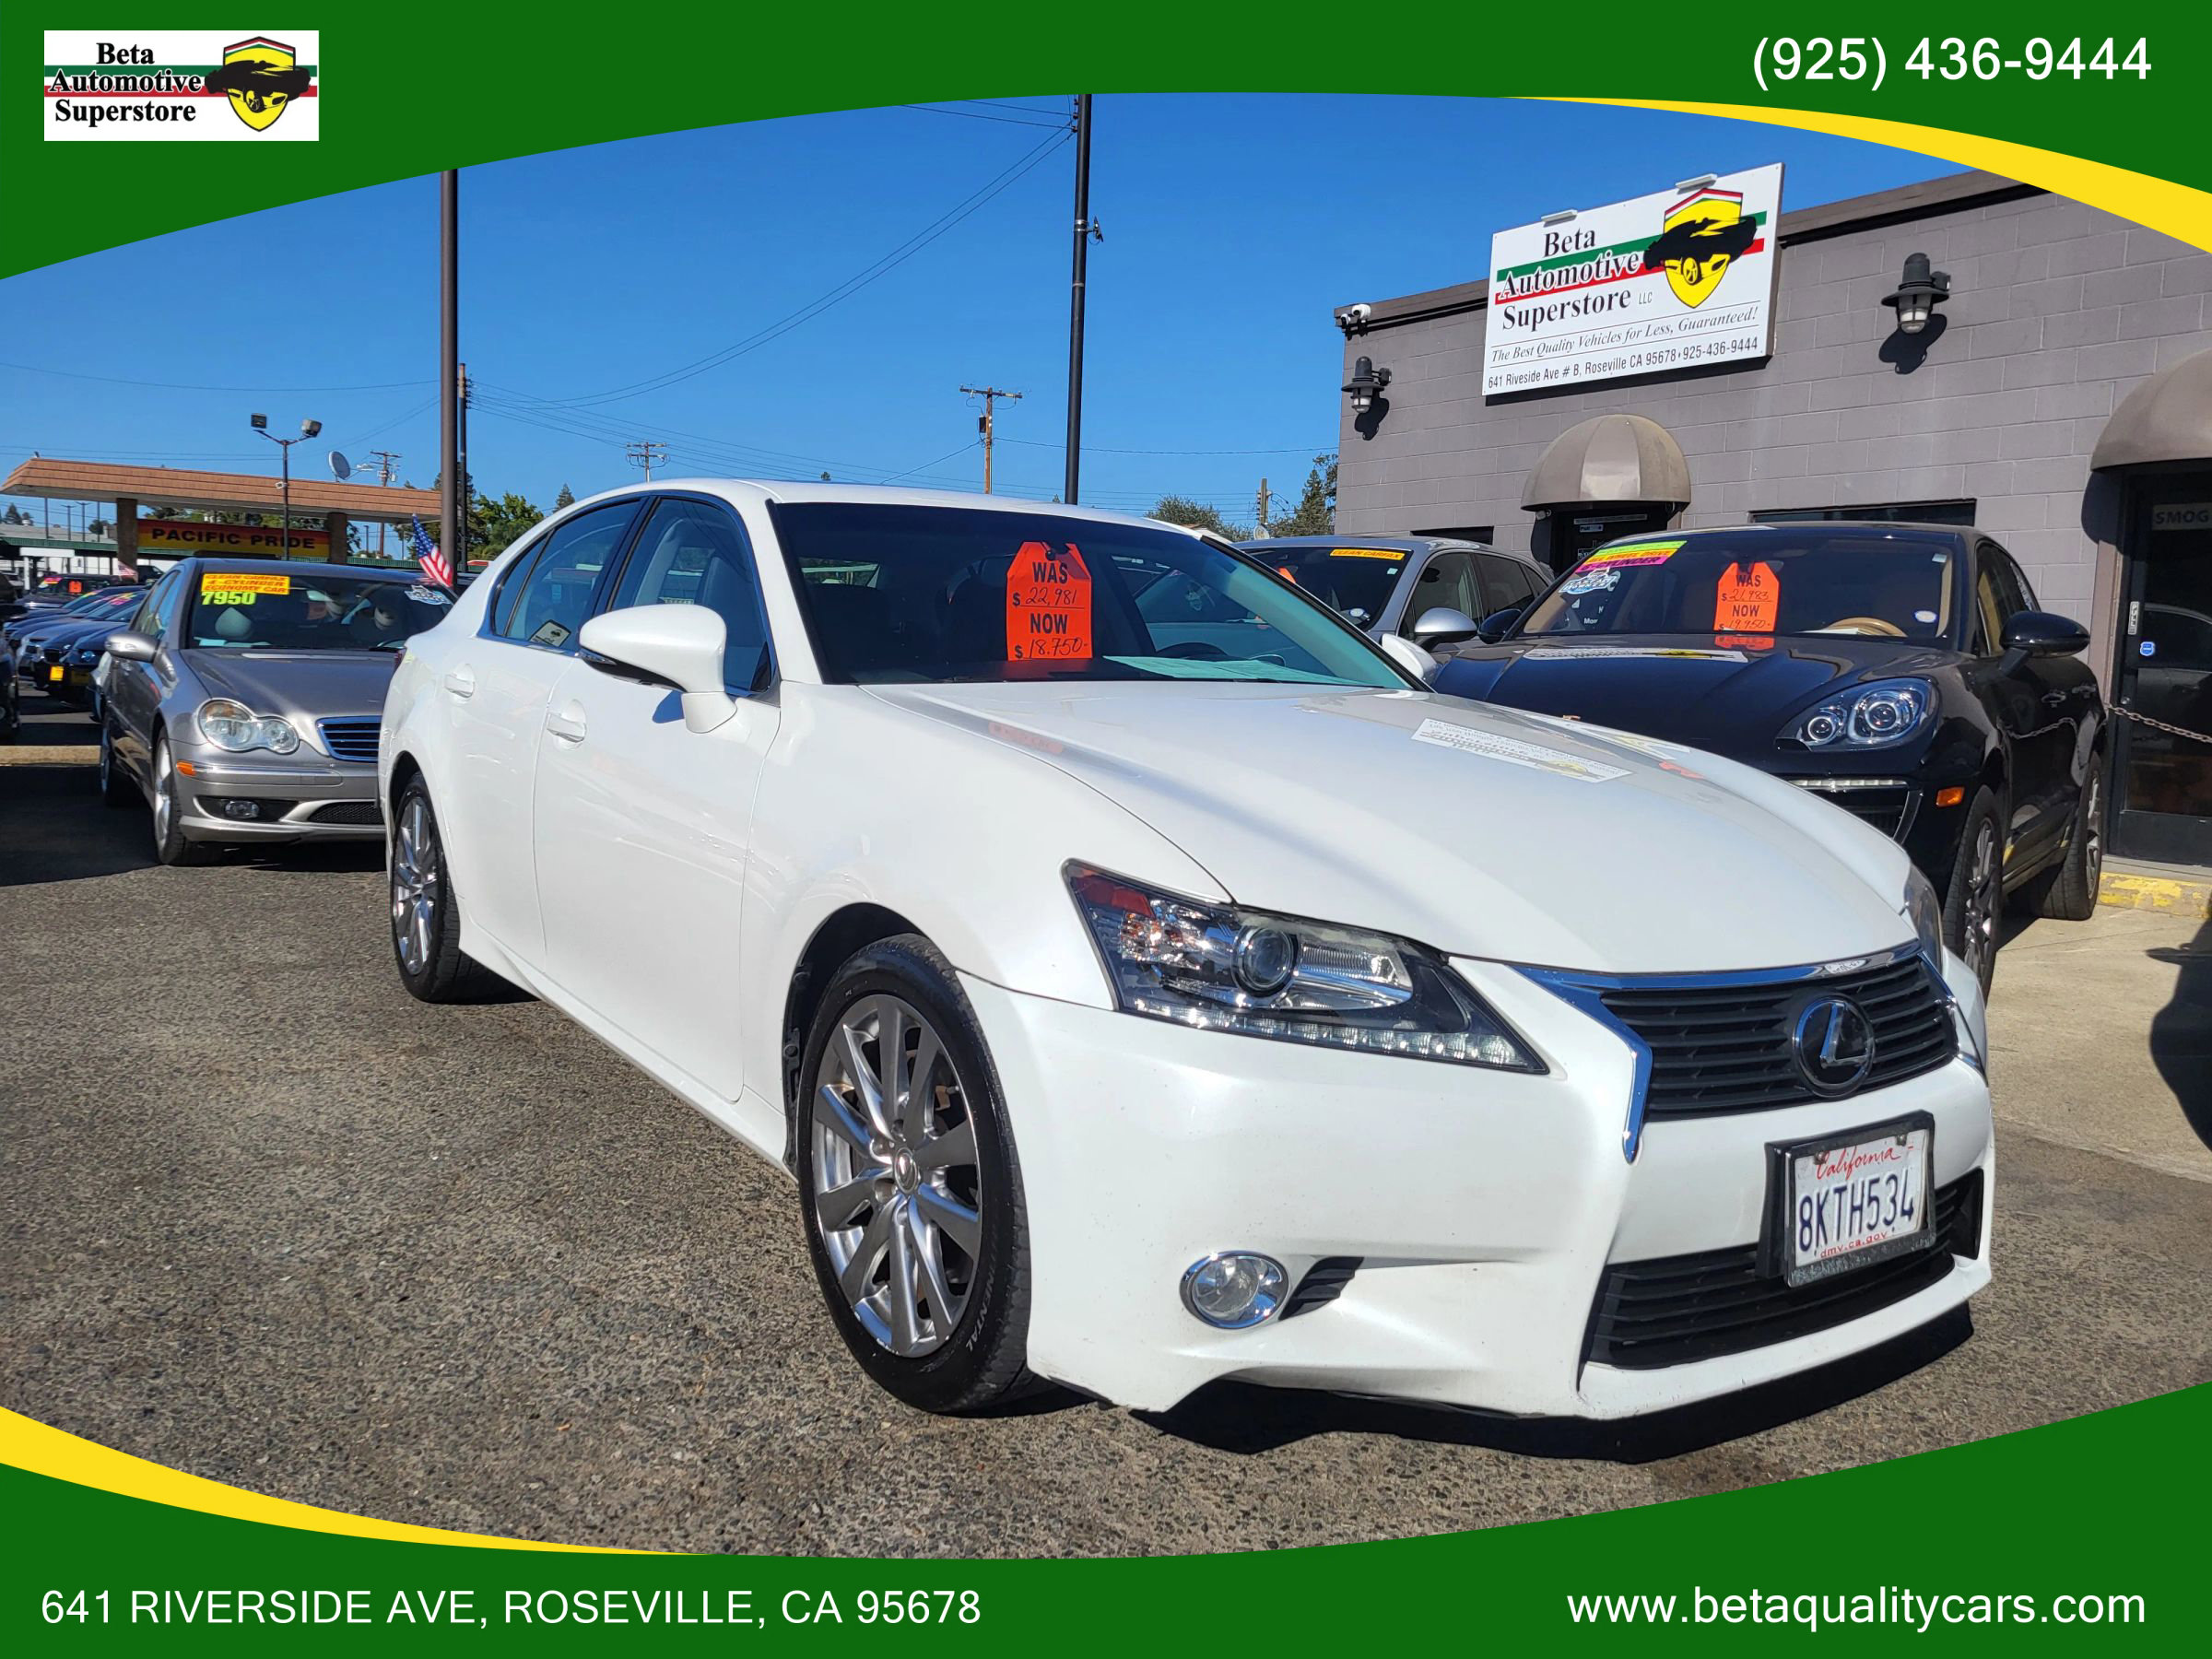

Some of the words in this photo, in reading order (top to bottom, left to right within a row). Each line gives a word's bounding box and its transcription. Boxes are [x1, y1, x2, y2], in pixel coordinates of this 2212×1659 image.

[1543, 229, 1596, 258] Beta
[1500, 252, 1640, 298] Automotive
[1502, 289, 1631, 332] Superstore
[1638, 291, 1653, 305] LLC
[1491, 349, 1511, 362] The
[1512, 347, 1534, 358] Best
[1536, 338, 1575, 357] Quality
[1578, 331, 1622, 347] Vehicles
[1624, 327, 1642, 344] for
[1644, 324, 1674, 337] Less,
[1678, 306, 1759, 332] Guaranteed!
[1488, 376, 1503, 389] 641
[1506, 371, 1541, 386] Riveside
[1543, 368, 1559, 381] Ave
[1562, 367, 1571, 377] #
[1572, 364, 1582, 377] B,
[1584, 358, 1627, 375] Roseville
[1630, 355, 1642, 368] CA
[1646, 349, 1677, 366] 95678
[2155, 510, 2209, 524] SMOG
[151, 528, 241, 546] PACIFIC
[250, 535, 316, 549] PRIDE
[1032, 561, 1068, 584] WAS
[1735, 574, 1761, 587] WAS
[201, 591, 257, 606] 7950
[1732, 605, 1760, 618] NOW
[1030, 612, 1068, 635] NOW
[1816, 1146, 1902, 1180] California
[1799, 1168, 1914, 1253] 8KTH534
[1819, 1231, 1889, 1259] dmv.ca.gov
